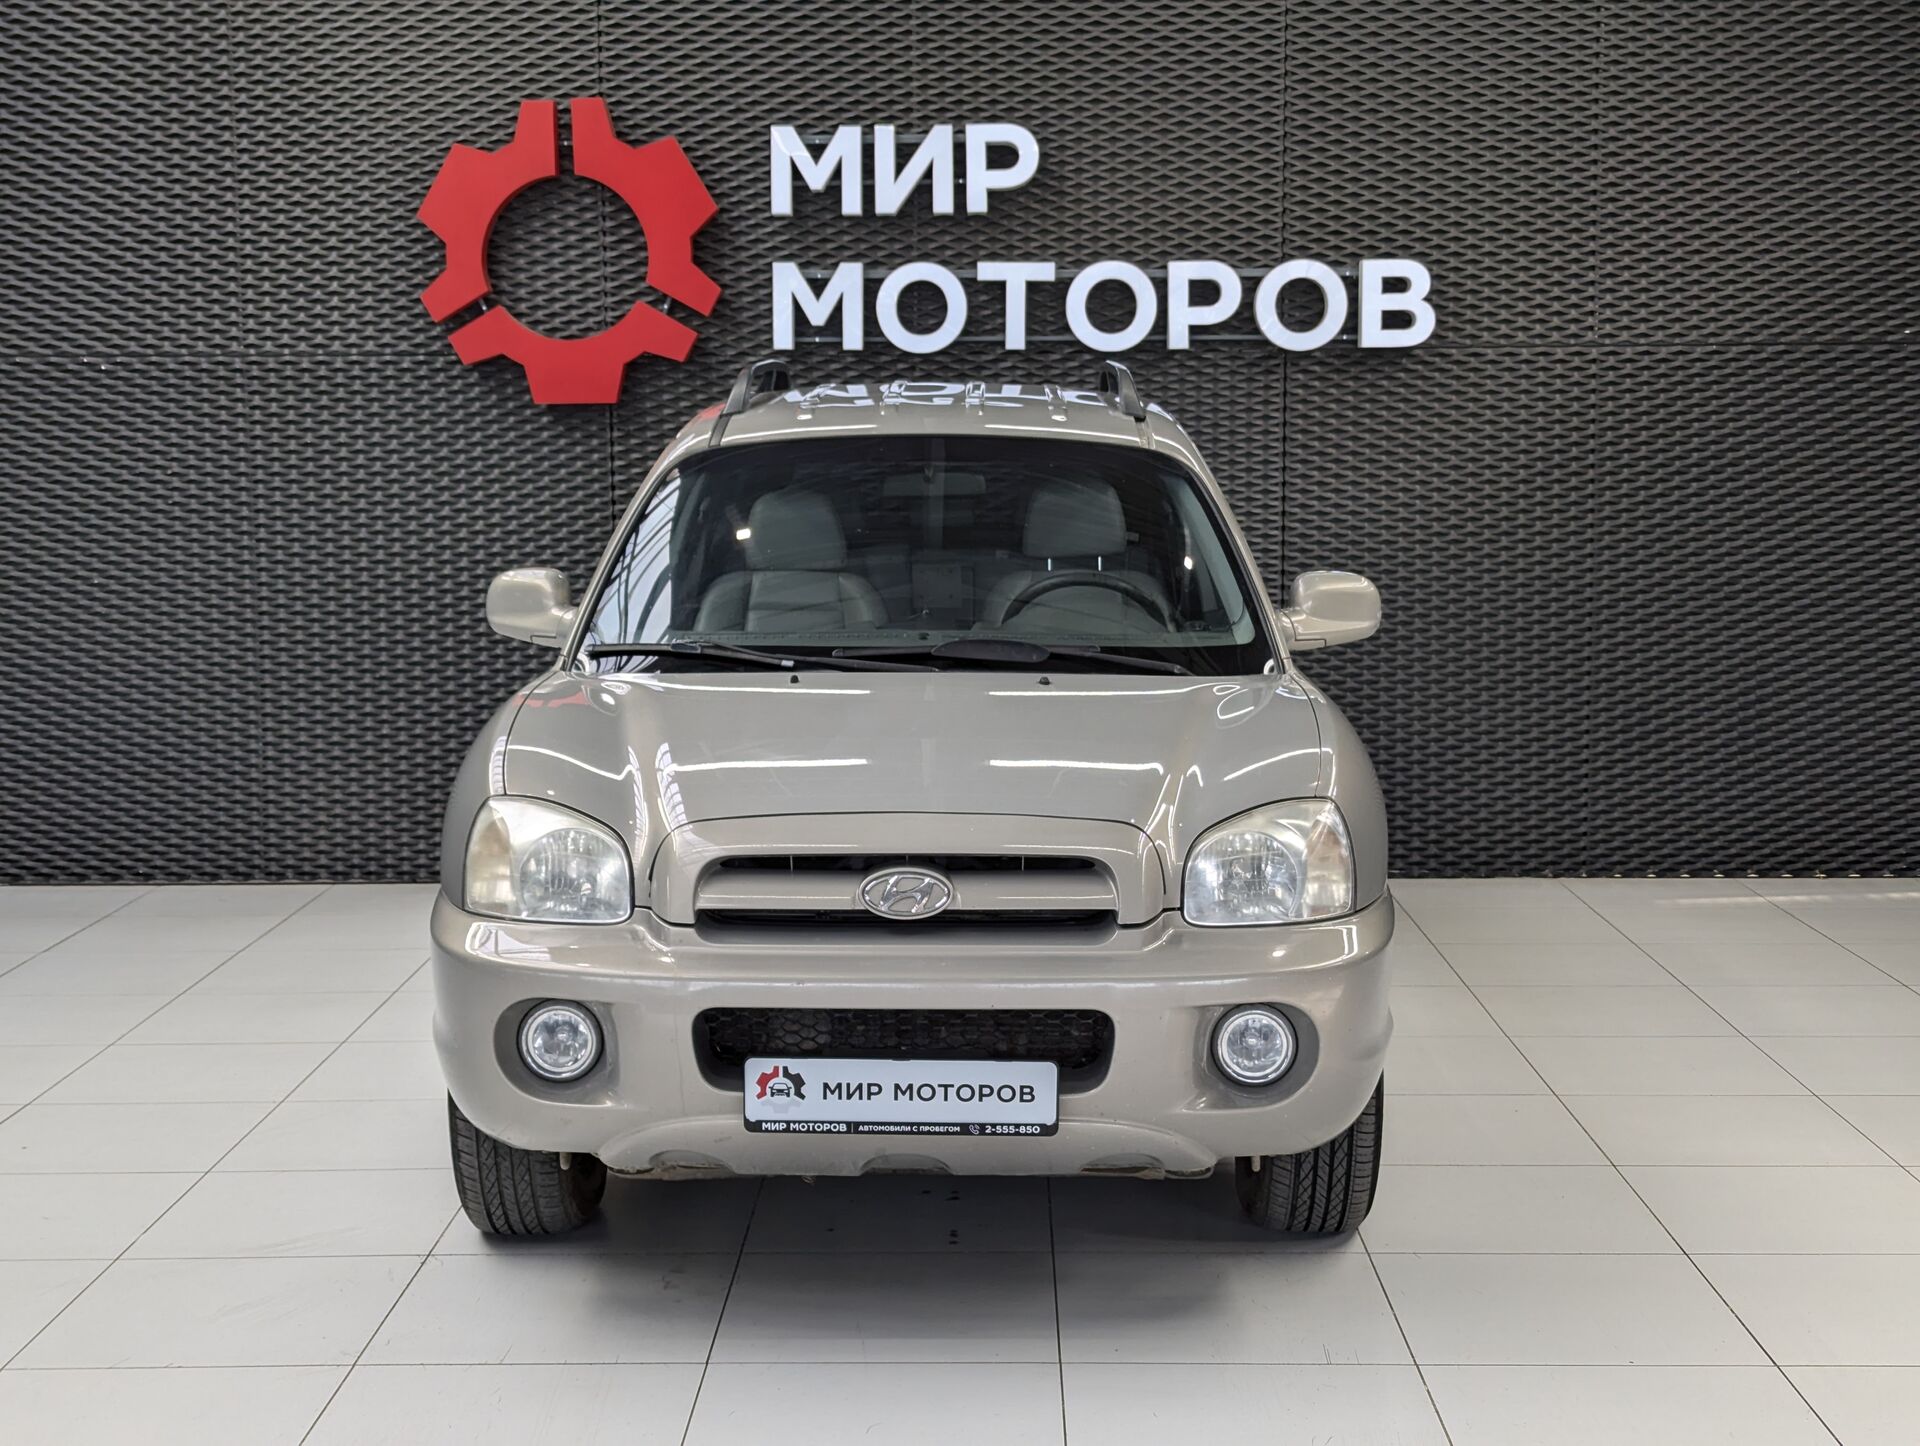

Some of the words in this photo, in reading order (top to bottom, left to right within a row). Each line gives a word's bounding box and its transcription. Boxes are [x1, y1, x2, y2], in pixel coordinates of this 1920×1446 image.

[770, 123, 1040, 216] МИР
[771, 259, 1437, 352] МОТОРОВ
[822, 1082, 883, 1100] МИР
[893, 1083, 1036, 1103] МОТОРОВ
[761, 1122, 787, 1131] МИР
[790, 1122, 847, 1132] МОТОРОВ
[858, 1125, 911, 1133] АВТОМОБИЛИ
[985, 1125, 1041, 1134] 2-555-850
